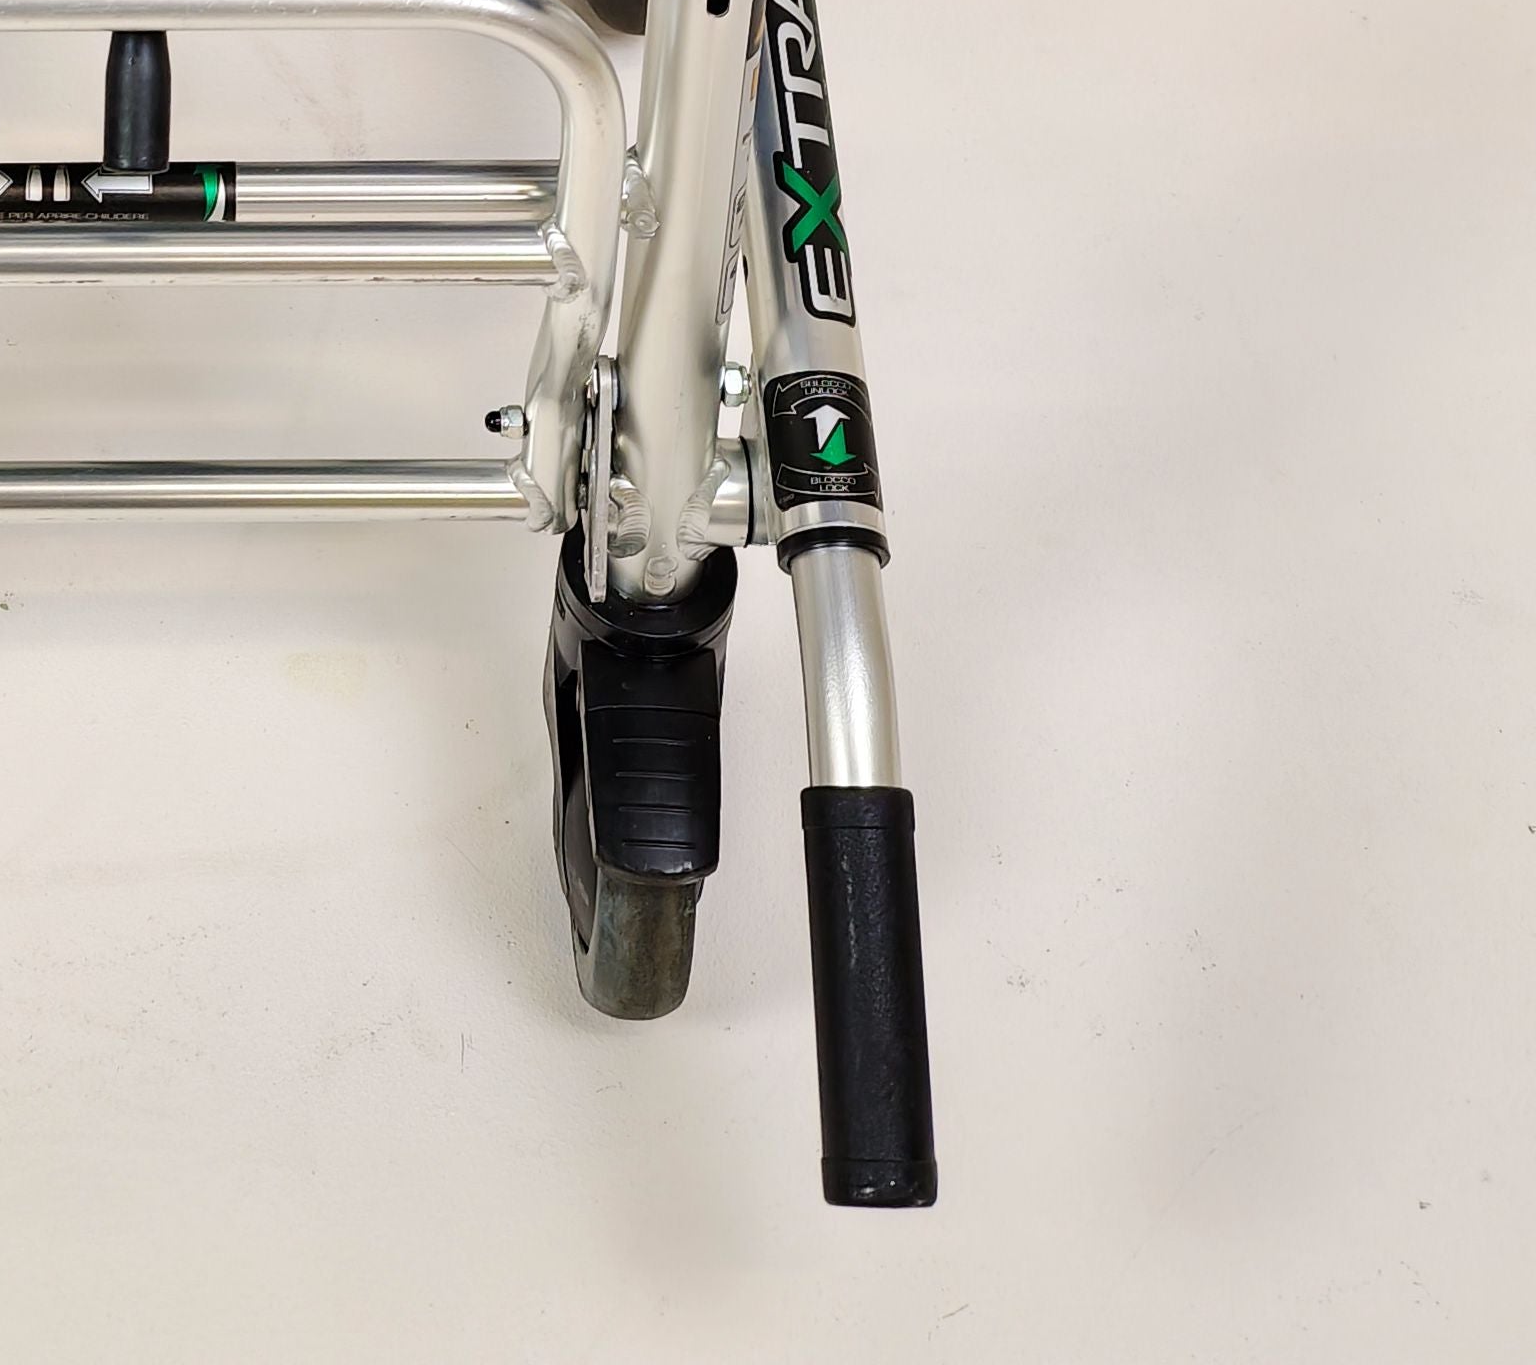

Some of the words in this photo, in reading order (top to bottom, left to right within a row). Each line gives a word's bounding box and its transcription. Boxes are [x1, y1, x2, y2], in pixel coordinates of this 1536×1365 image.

[8, 212, 34, 220] PER
[810, 476, 857, 485] BLOCCO
[819, 483, 850, 492] LOCK
